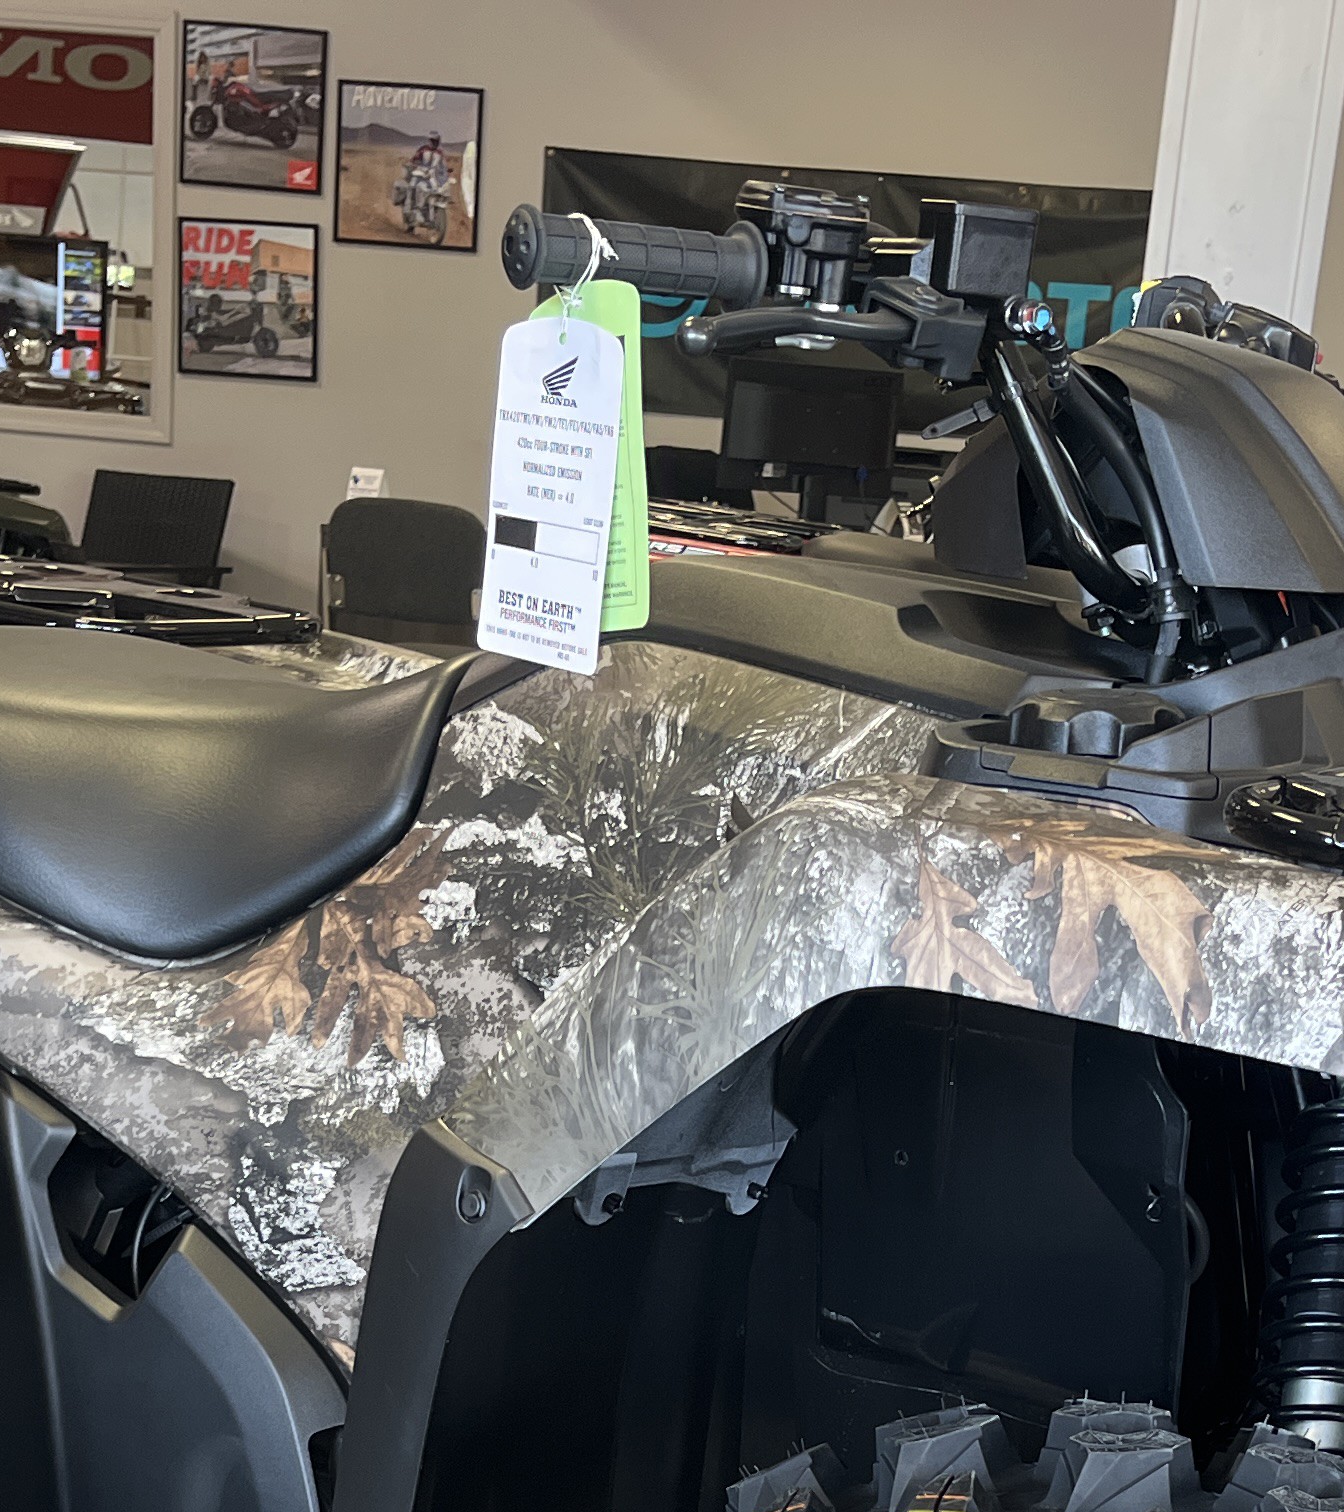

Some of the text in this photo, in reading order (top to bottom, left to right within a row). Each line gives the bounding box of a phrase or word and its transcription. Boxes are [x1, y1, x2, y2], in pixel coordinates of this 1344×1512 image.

[182, 225, 255, 255] RIDE
[183, 260, 251, 291] FUN
[541, 395, 577, 408] HONDA
[523, 461, 582, 481] NORMALIZED EMISSION
[498, 589, 524, 607] BEST
[527, 595, 538, 612] ON
[500, 608, 547, 630] PERFORMANCE
